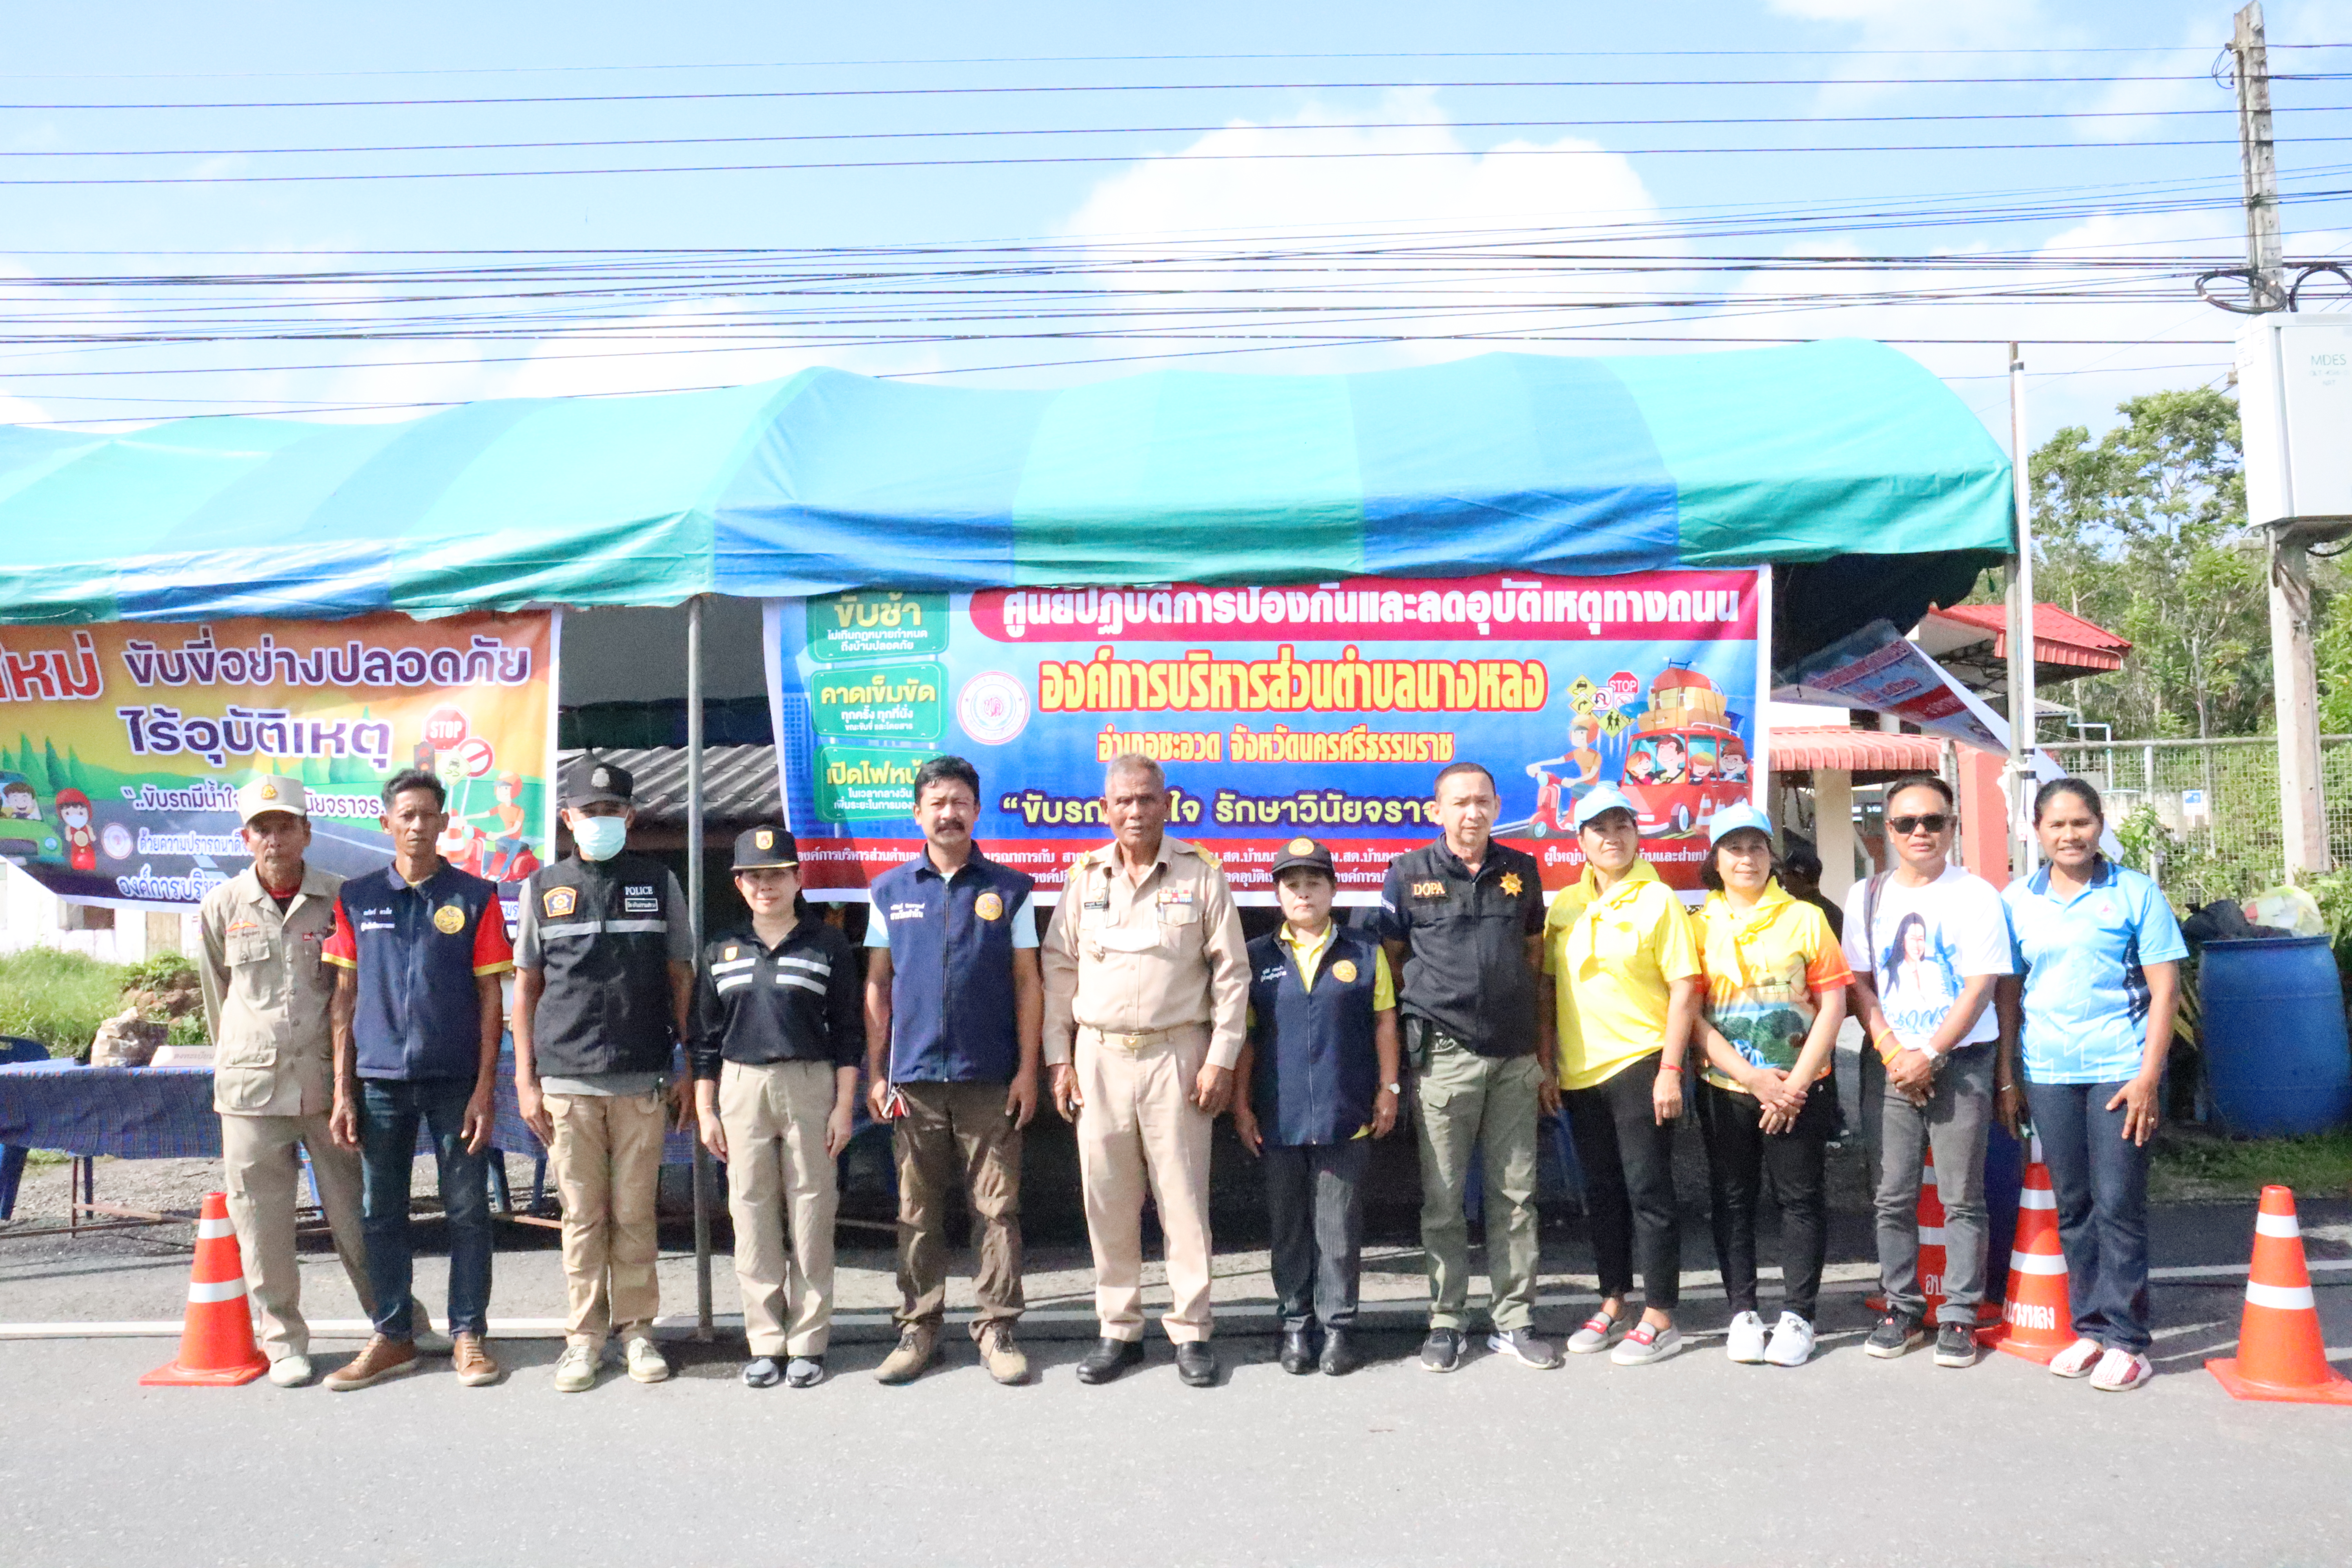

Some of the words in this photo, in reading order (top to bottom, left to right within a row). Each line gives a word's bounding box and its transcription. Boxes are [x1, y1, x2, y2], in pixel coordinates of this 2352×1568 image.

[2311, 354, 2346, 365] MDES
[841, 640, 914, 651] ถึงบ้านปลอดภัย
[0, 632, 102, 700] หม่
[123, 626, 529, 686] ขับขี่อย่างปลอดภัย
[1041, 646, 1545, 710] องค์การบริหารส่วนตำบลนางหลง
[1609, 680, 1637, 692] STOP
[821, 675, 936, 704] คาดเข็มขัด
[841, 705, 875, 723] ทุกครั้ง
[877, 704, 913, 722] ทุกที่นั่ง
[118, 706, 391, 769] ไร้อุบัติเหตุ
[430, 720, 462, 739] STOP
[1230, 724, 1454, 761] จังหวัดนครศรีธรรมราช
[827, 759, 922, 784] เปิดไฟหน้
[625, 886, 653, 895] POLICE
[1414, 882, 1445, 896] DOPA
